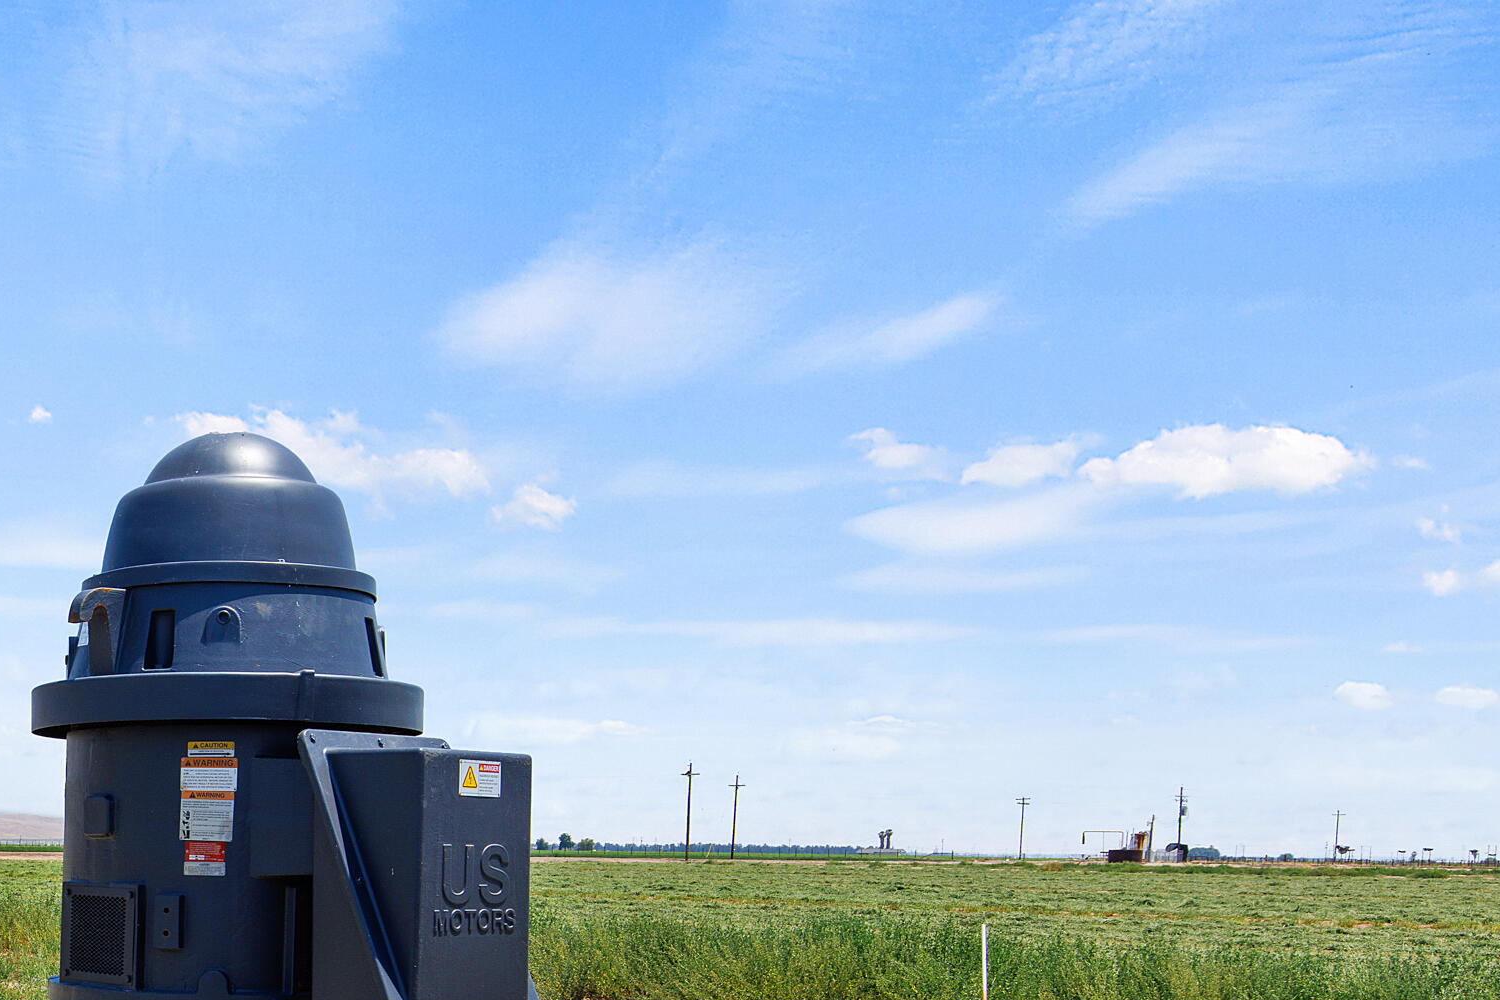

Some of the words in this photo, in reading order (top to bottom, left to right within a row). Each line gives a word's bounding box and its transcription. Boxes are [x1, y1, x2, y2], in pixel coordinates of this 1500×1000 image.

[193, 759, 234, 767] WARNING
[483, 764, 499, 772] DANGER
[442, 843, 509, 906] US
[433, 908, 516, 937] MOTORS
